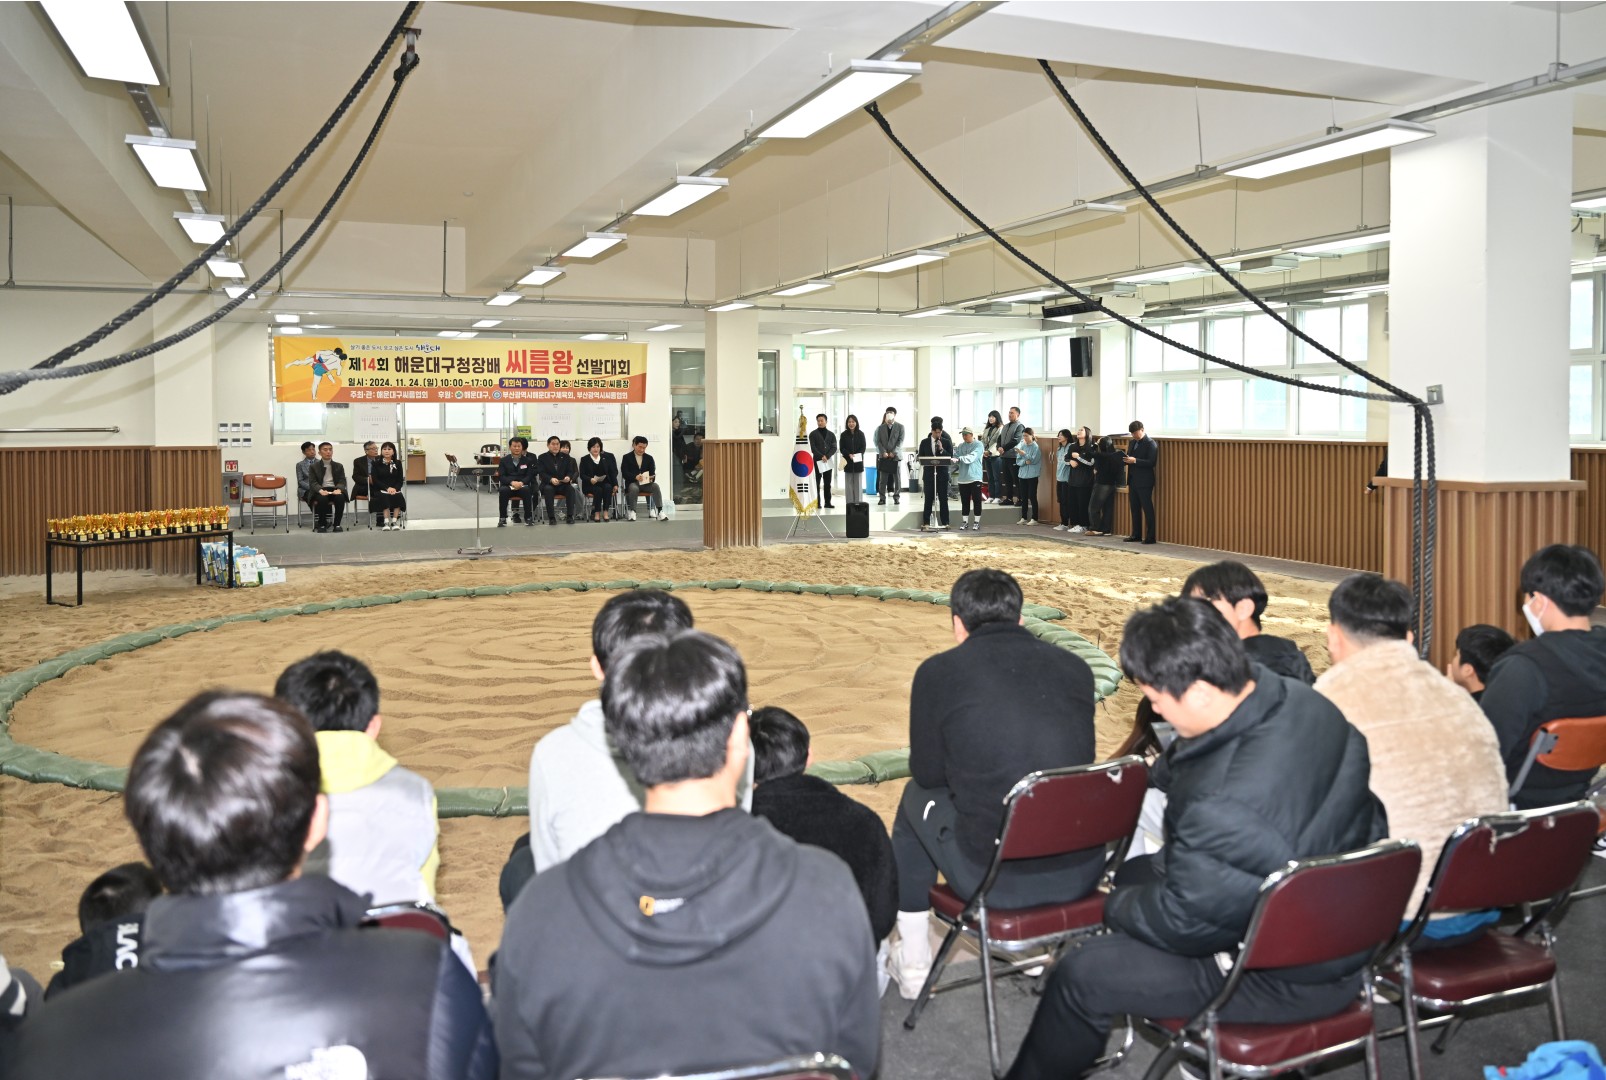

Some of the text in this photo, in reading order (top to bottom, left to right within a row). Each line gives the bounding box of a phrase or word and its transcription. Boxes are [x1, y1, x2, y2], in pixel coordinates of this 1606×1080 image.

[348, 349, 631, 375] 제14회 해운대구청장배 씨름왕 선발대회
[369, 378, 393, 387] 2024.
[395, 378, 407, 387] 11.
[573, 379, 607, 388] 신곡중학교
[608, 379, 630, 388] 씨름장
[376, 390, 429, 399] 해운대구씨름협회
[576, 391, 628, 399] 부산광역시씨름협회
